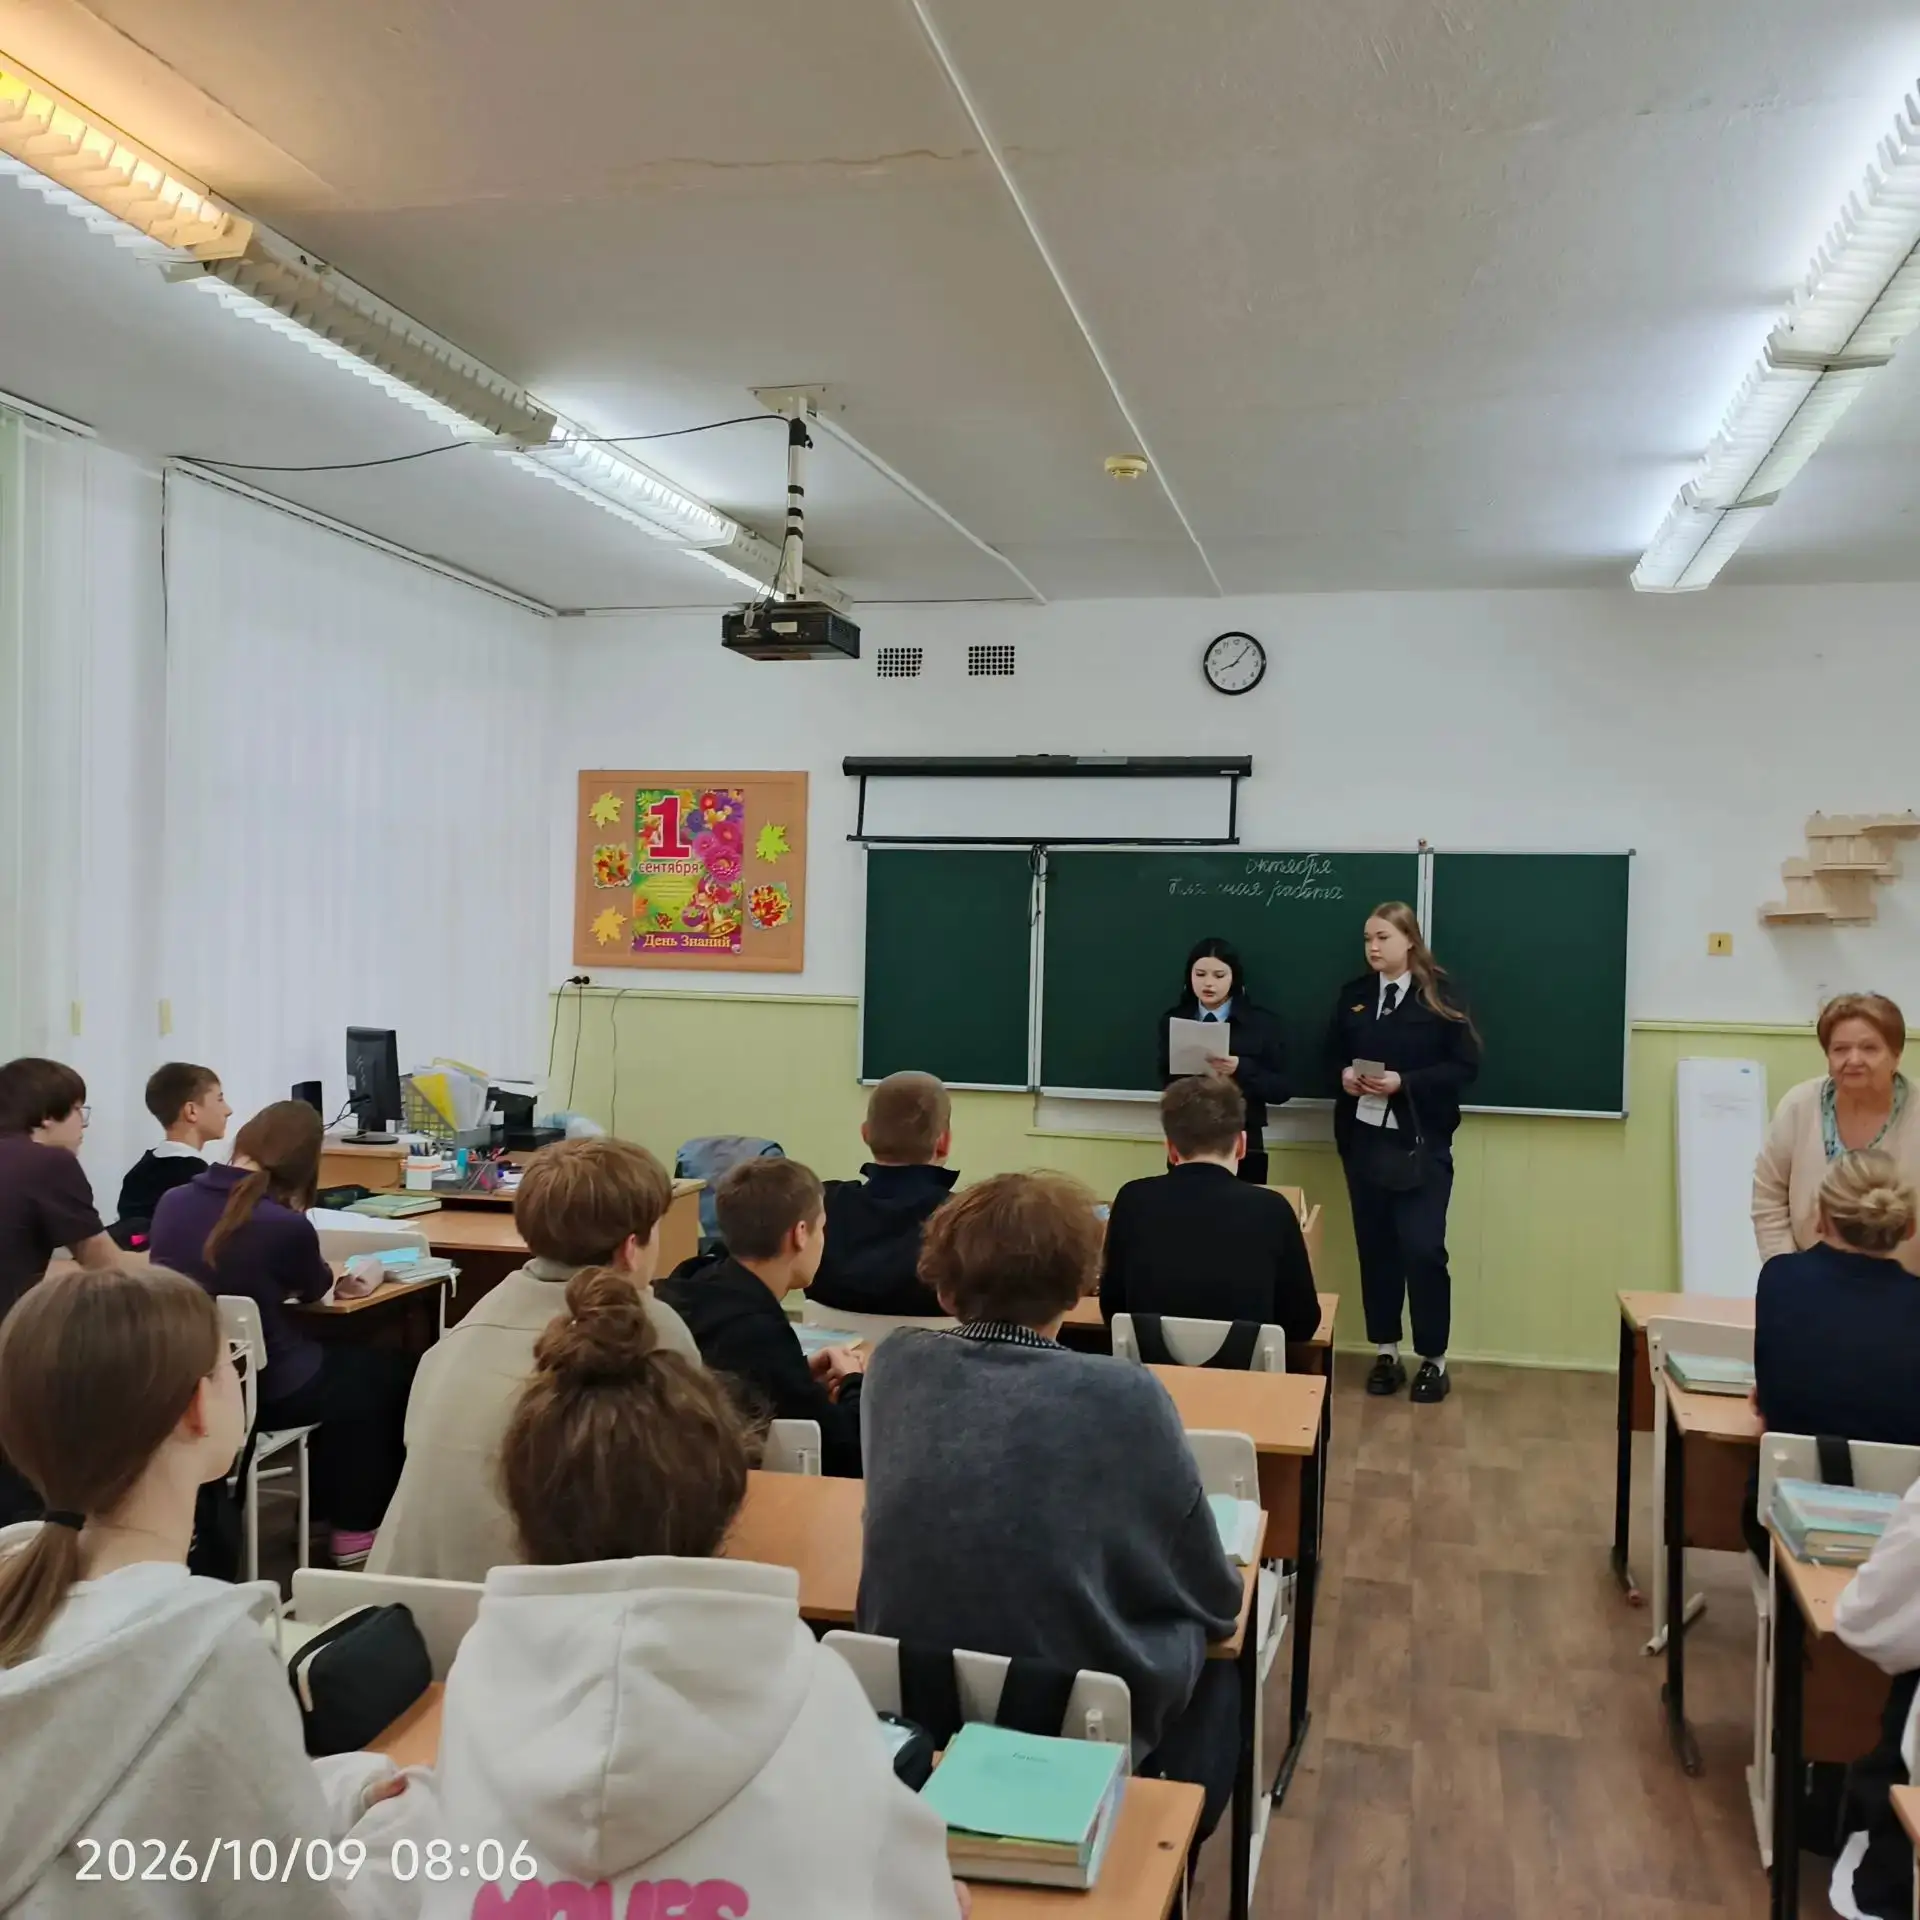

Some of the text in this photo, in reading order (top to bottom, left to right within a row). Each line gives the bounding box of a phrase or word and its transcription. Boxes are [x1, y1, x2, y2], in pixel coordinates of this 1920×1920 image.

[648, 795, 692, 859] 1
[639, 860, 699, 876] сентября
[643, 934, 731, 948] День Знаний
